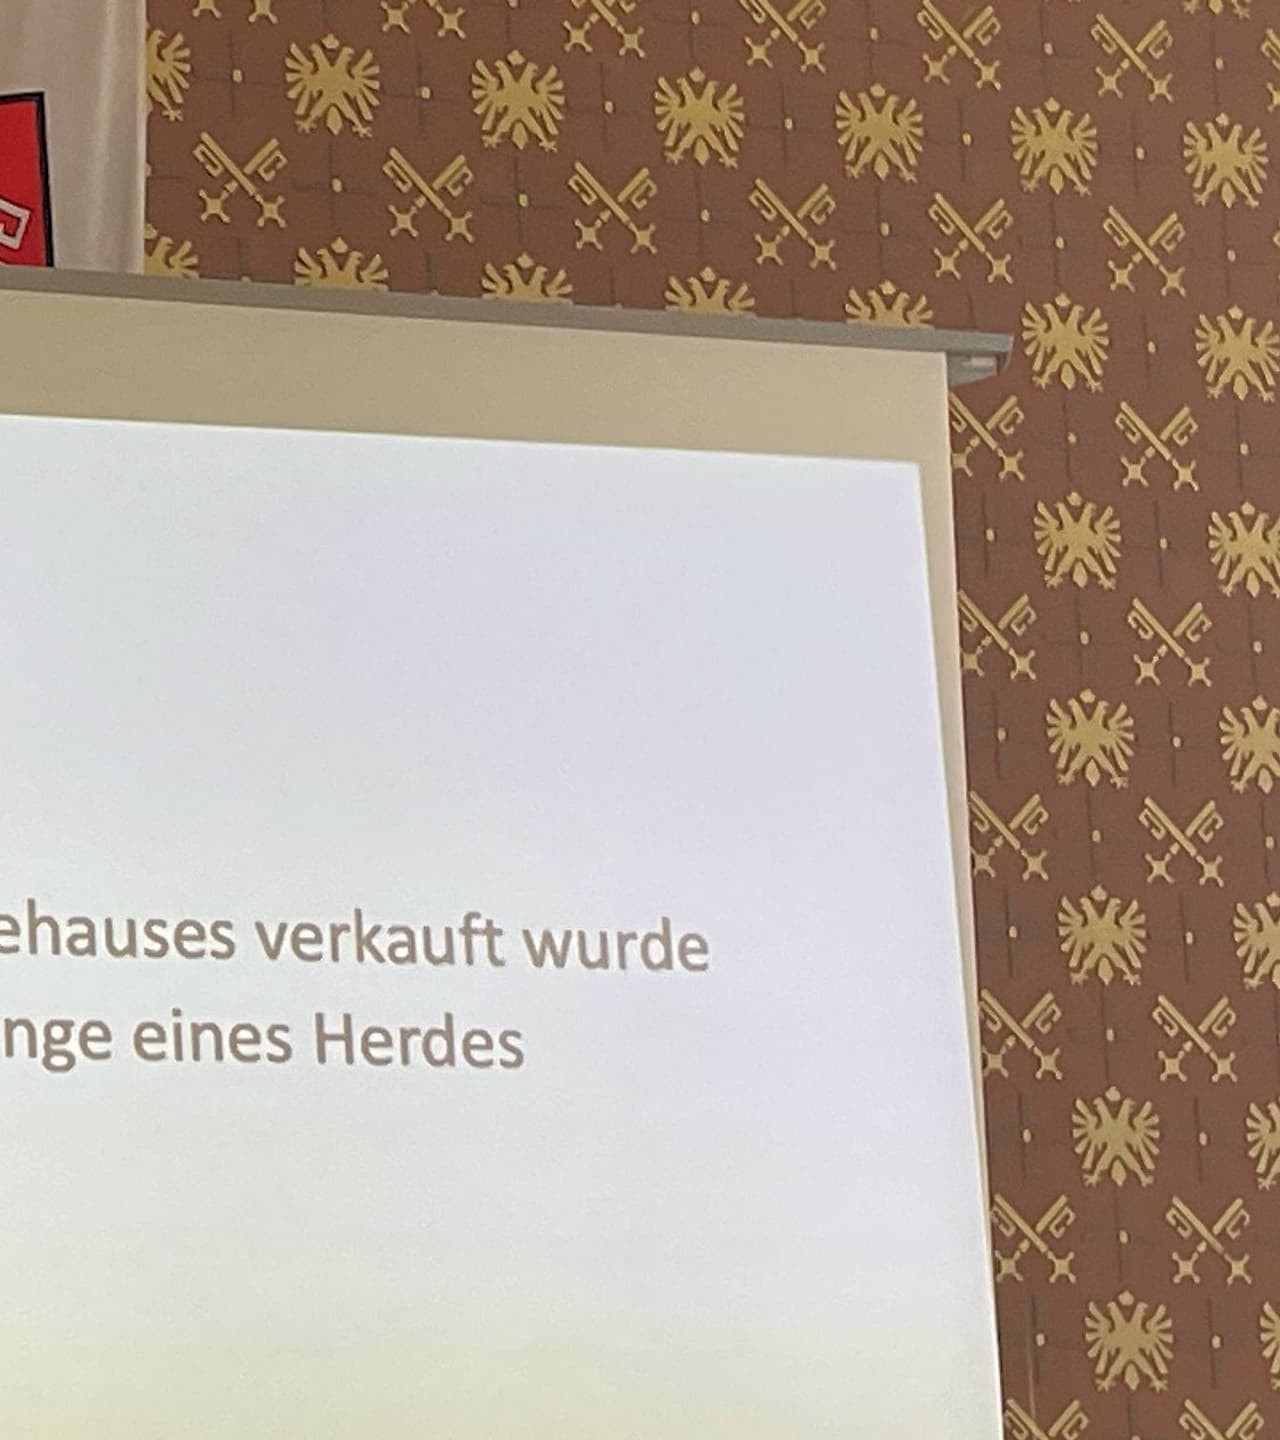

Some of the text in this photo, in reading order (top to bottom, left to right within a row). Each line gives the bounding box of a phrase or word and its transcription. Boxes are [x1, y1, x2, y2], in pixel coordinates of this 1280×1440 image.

[255, 908, 506, 967] verkauft
[522, 917, 709, 972] wurde
[133, 1008, 293, 1063] eines
[315, 1012, 524, 1069] Herdes
